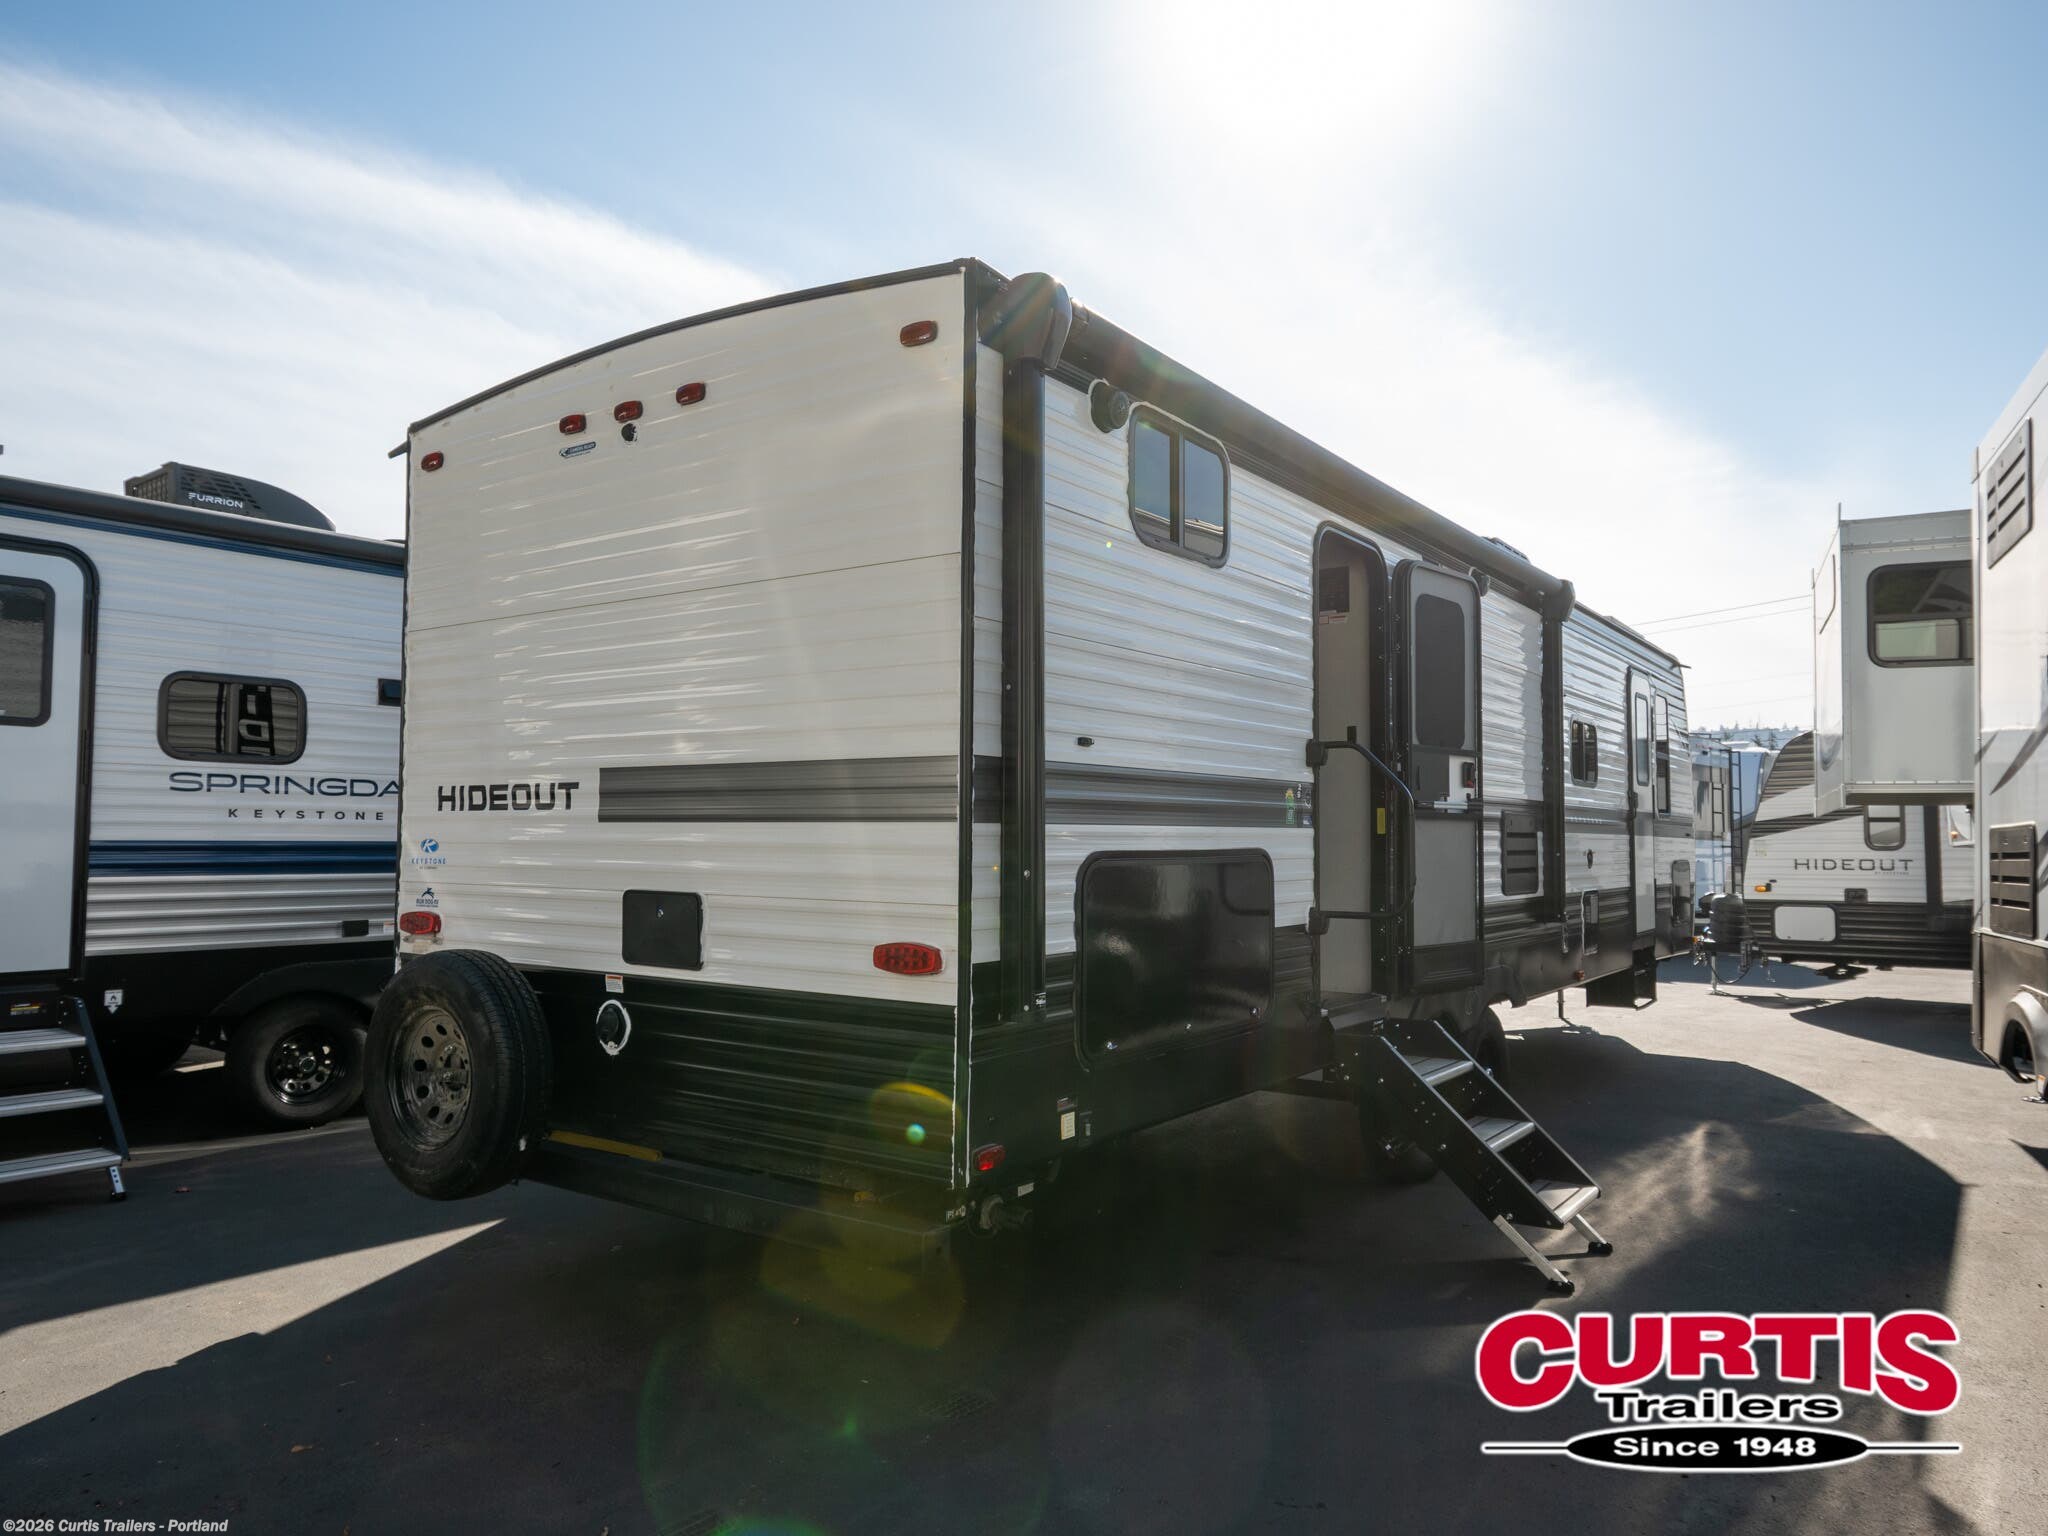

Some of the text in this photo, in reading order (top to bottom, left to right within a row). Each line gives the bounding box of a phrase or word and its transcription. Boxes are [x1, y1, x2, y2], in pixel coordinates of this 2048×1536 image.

[188, 492, 243, 509] FURRION
[437, 781, 580, 812] HIDEOUT
[228, 808, 384, 821] KEYSTONE
[1794, 858, 1913, 871] HIDEOUT
